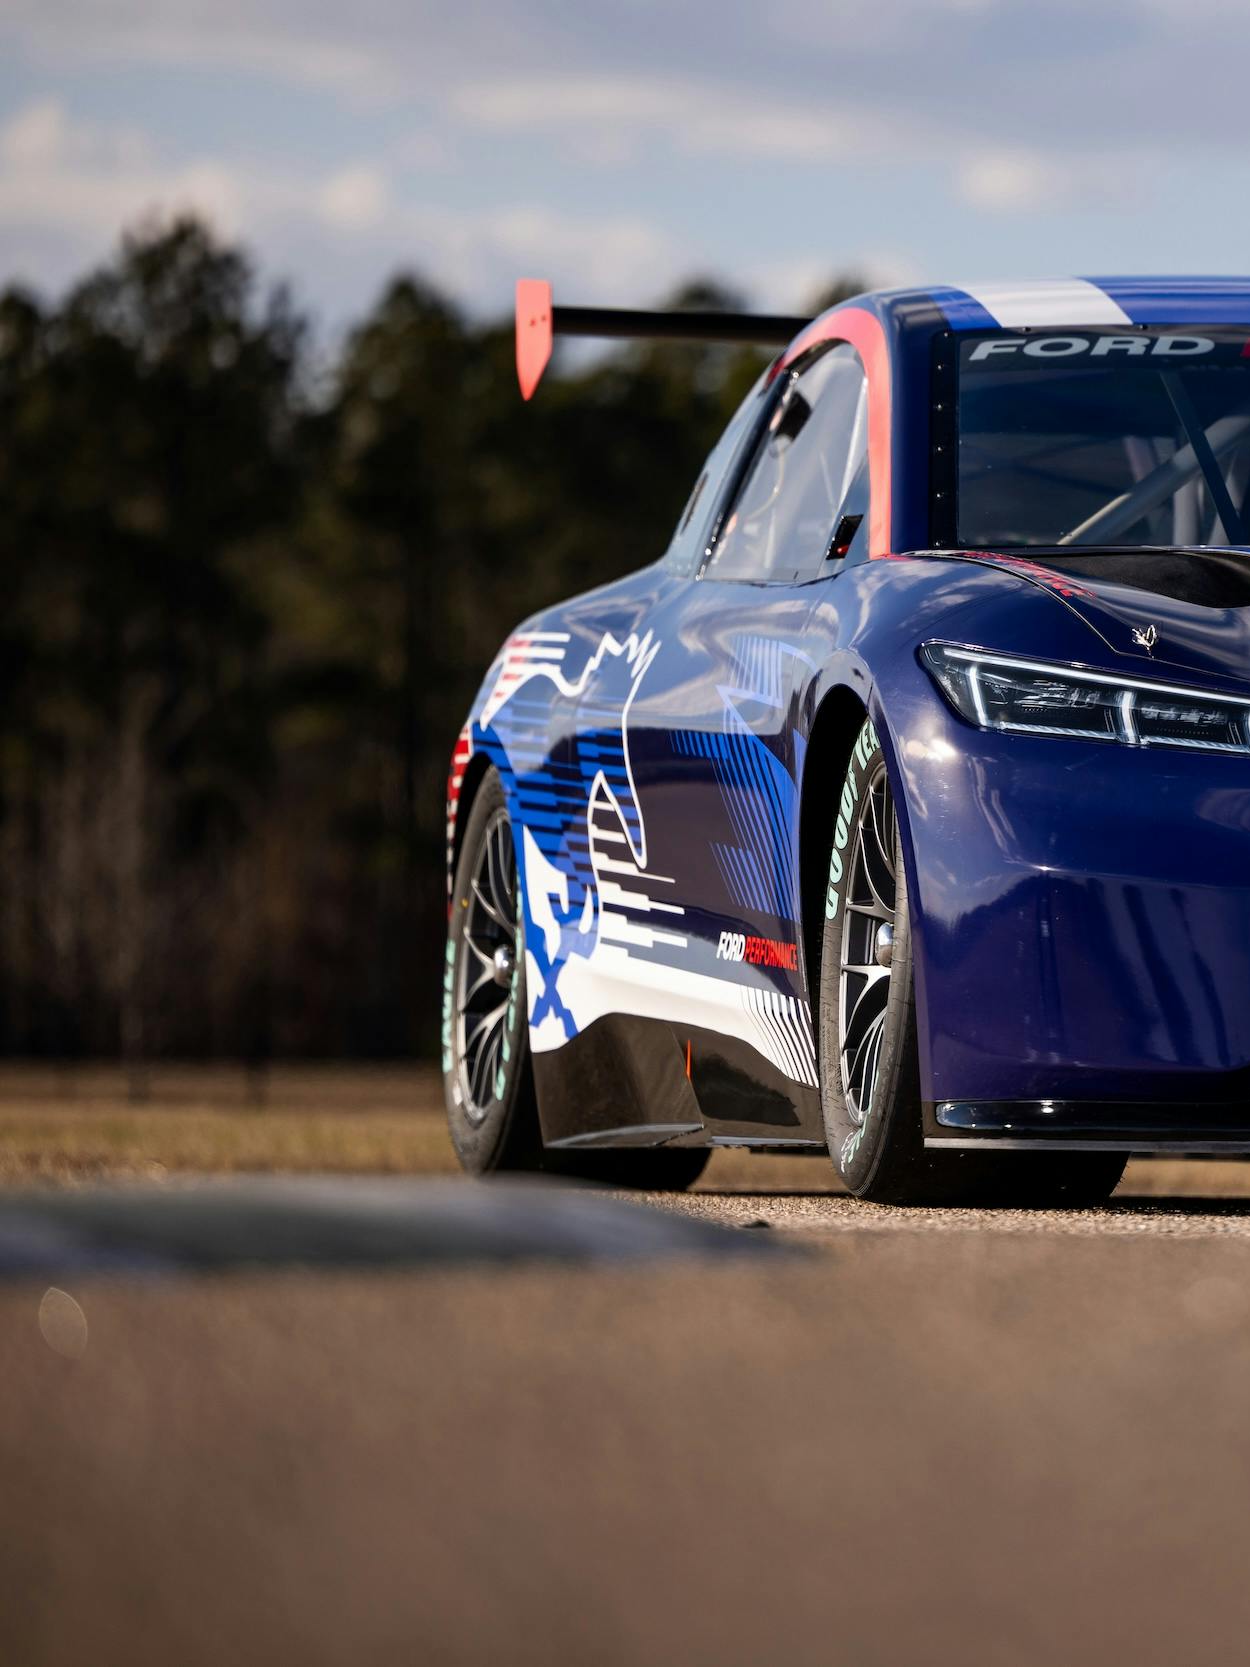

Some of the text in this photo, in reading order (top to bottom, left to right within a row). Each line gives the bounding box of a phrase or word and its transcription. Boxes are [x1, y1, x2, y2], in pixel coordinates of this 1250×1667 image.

[968, 335, 1216, 361] FORD
[825, 720, 881, 920] GOODYEA
[716, 930, 798, 972] FORD PERFORMANCE
